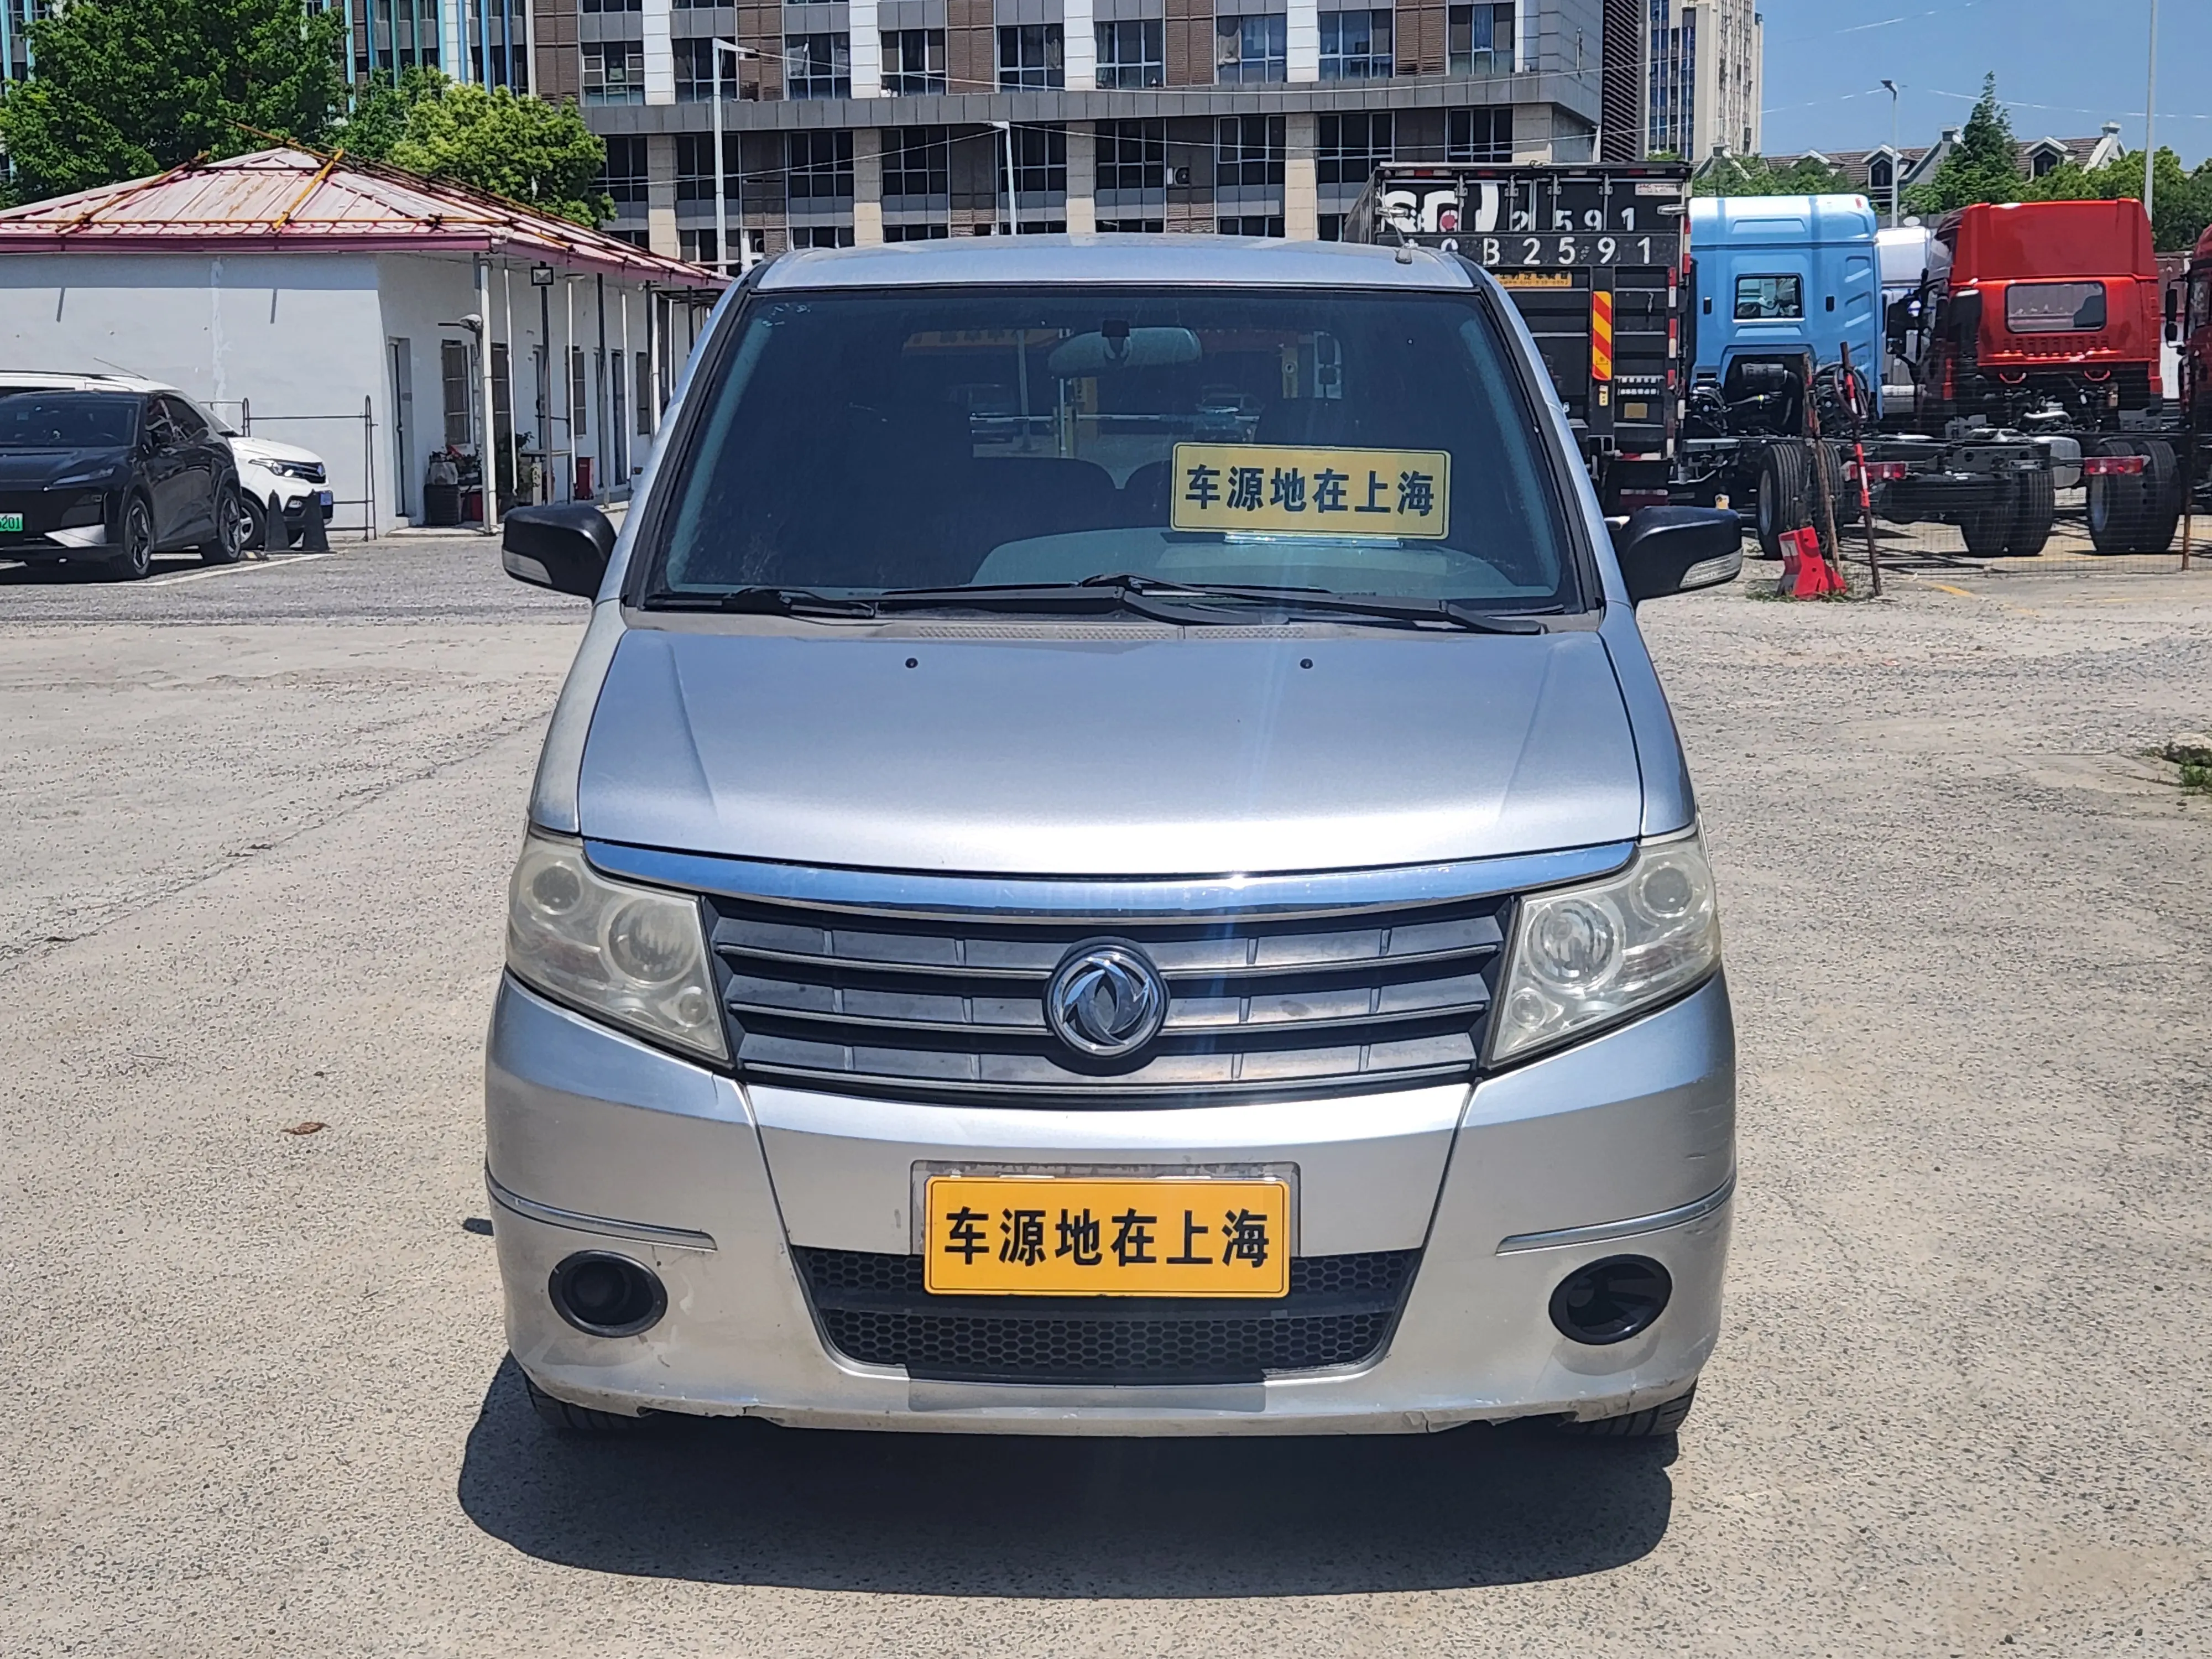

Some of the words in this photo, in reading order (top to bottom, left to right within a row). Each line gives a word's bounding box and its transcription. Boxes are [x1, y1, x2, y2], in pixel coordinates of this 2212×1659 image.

[1185, 464, 1434, 517] 车源地在上海
[0, 516, 20, 529] 201
[945, 1206, 1270, 1268] 车源地在上海
